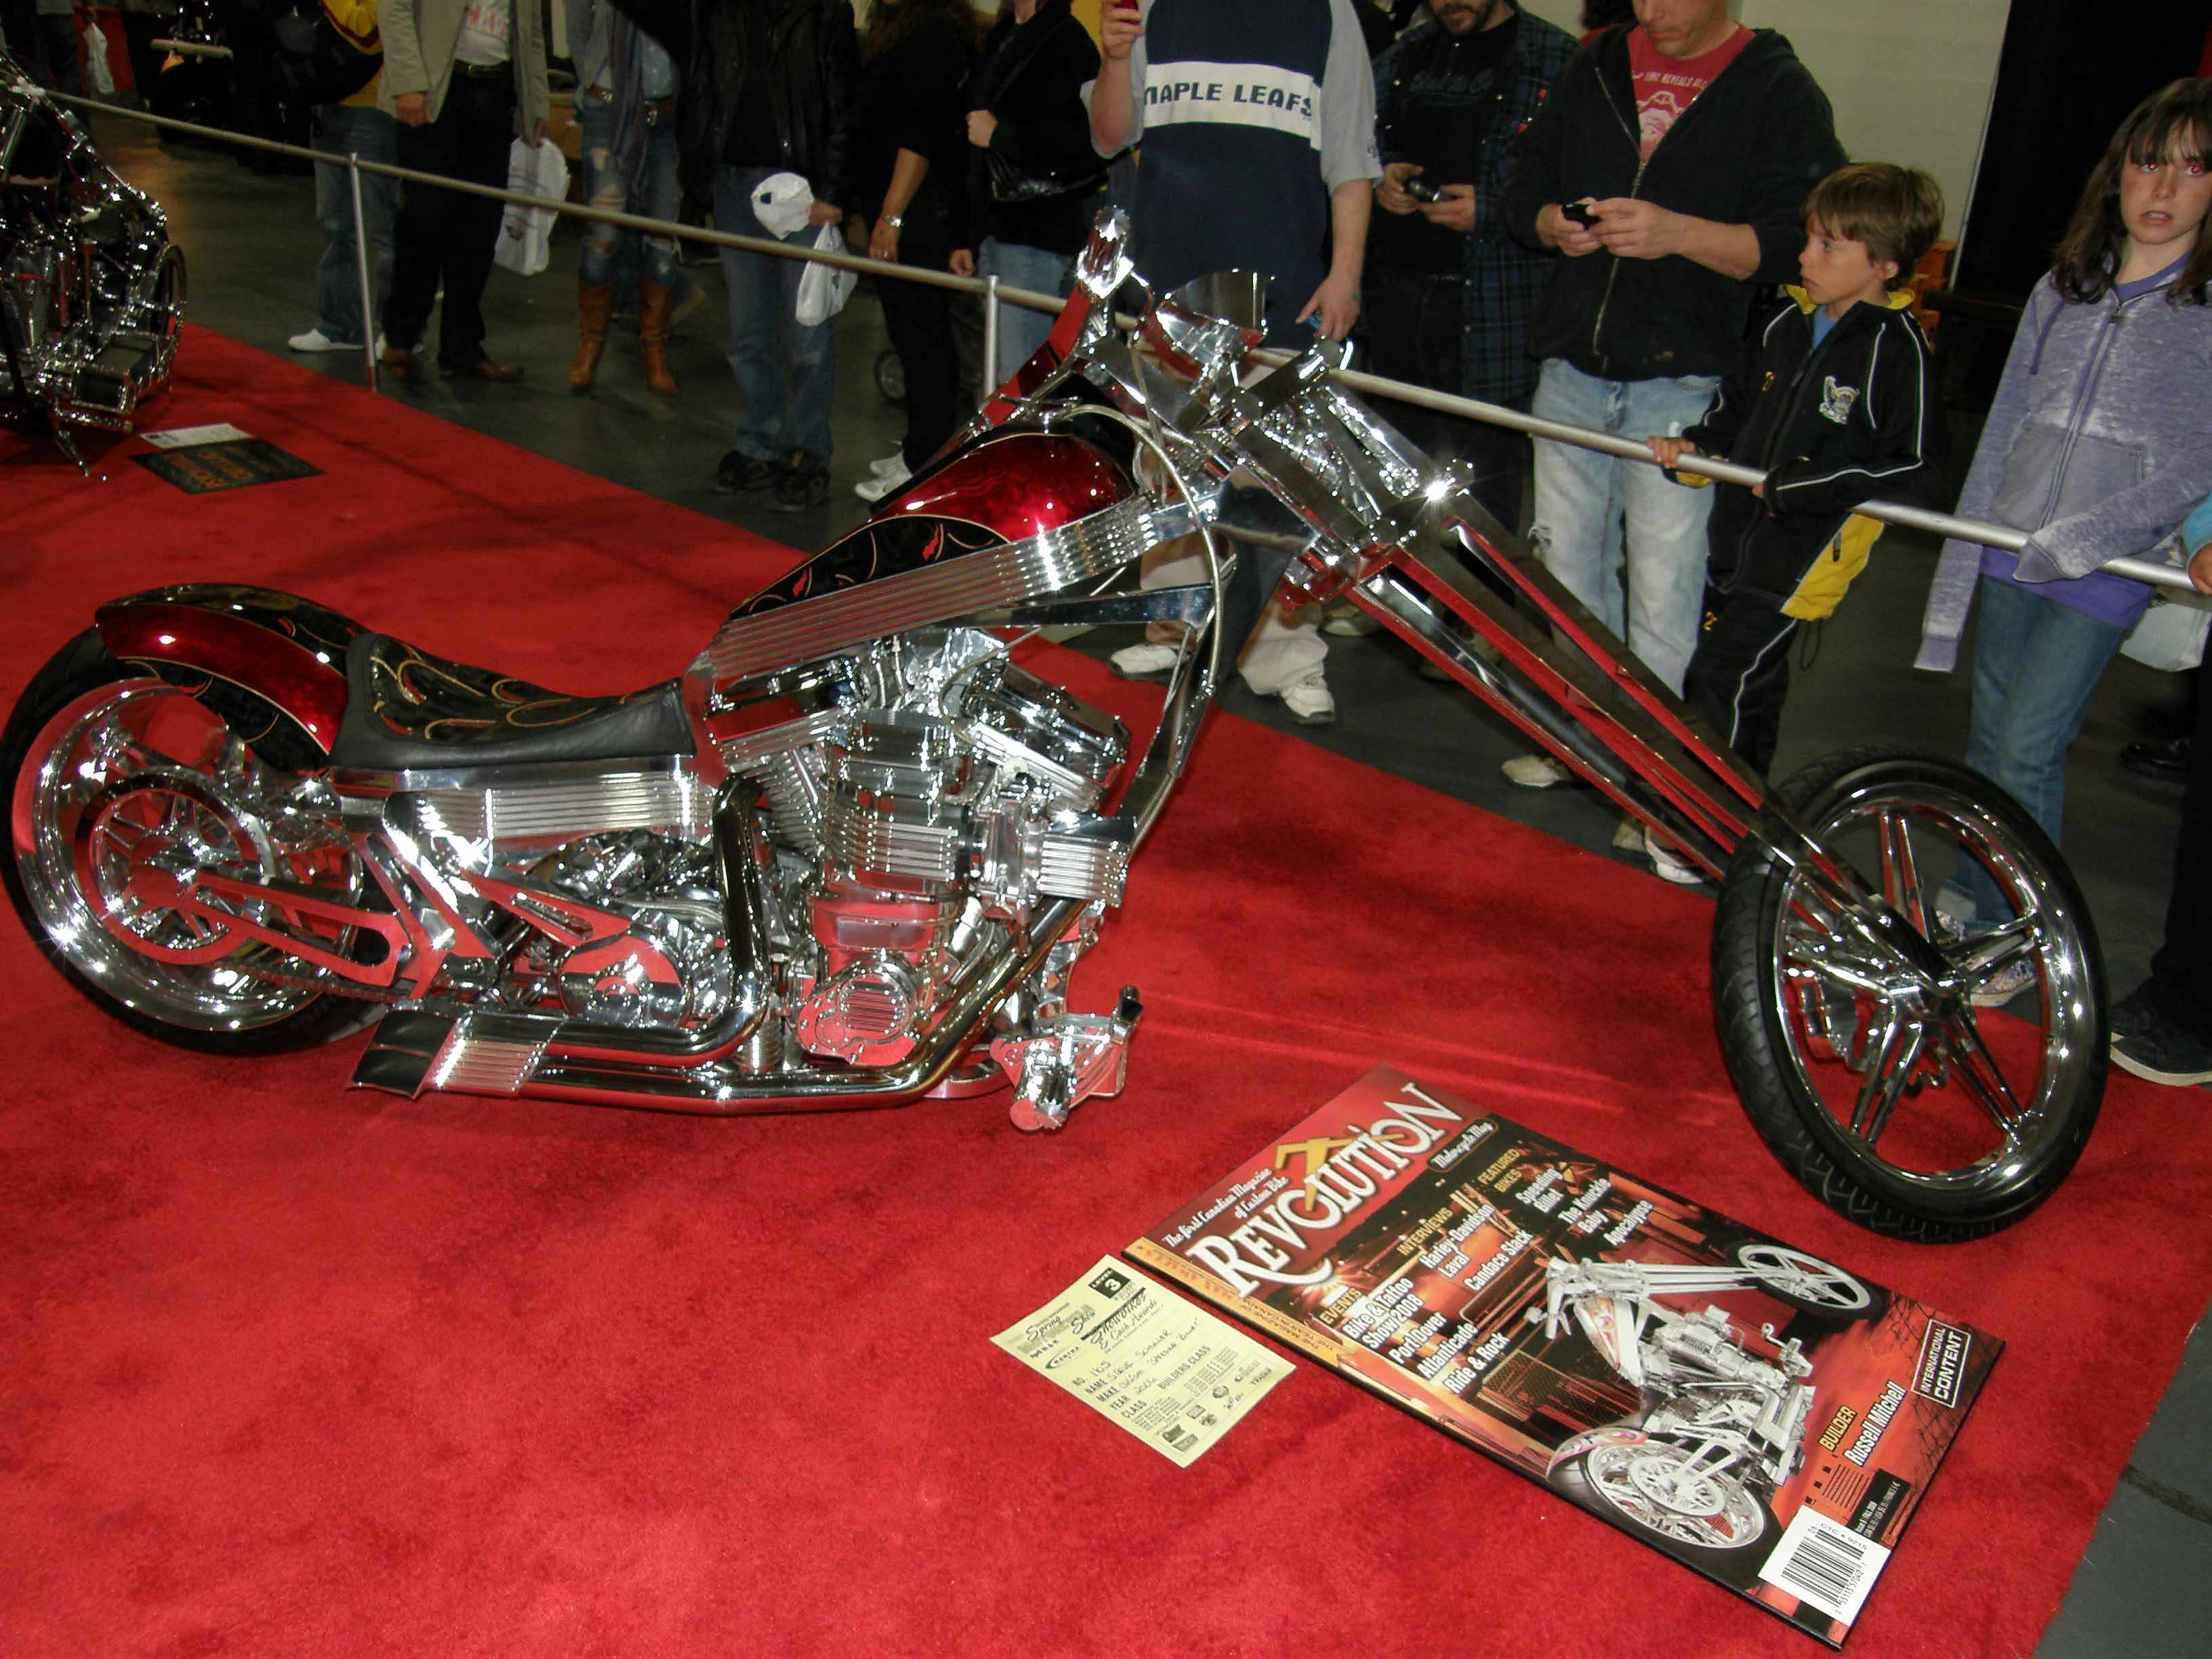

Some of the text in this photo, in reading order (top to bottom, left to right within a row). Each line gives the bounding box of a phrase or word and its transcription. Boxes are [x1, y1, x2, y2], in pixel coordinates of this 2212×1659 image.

[1144, 82, 1312, 117] MAPLE LEAFS
[1477, 1147, 1521, 1186] FEATURED
[1494, 1168, 1523, 1194] BIKES
[1515, 1167, 1564, 1206] Speeding
[1162, 1232, 1185, 1248] The
[1197, 1193, 1238, 1223] Canadian
[1228, 1168, 1273, 1198] Magazine
[1234, 1176, 1290, 1219] of Custom Bike
[1534, 1187, 1565, 1214] Billet
[1557, 1177, 1613, 1225] The Knuckle
[1396, 1208, 1454, 1256] INTERVIEWS
[1418, 1202, 1497, 1269] Harley-Davidson
[1577, 1209, 1611, 1234] Baby
[1603, 1200, 1654, 1247] Apocalypse
[1437, 1252, 1471, 1279] Laval
[1463, 1229, 1534, 1291] Candace Slack
[1104, 1278, 1122, 1292] 3
[1319, 1286, 1362, 1324] EVENTS
[1025, 1315, 1063, 1343] Spring
[1071, 1312, 1096, 1335] Show
[1341, 1277, 1415, 1340] Bike & Tattoo
[1361, 1293, 1425, 1350] Show 2008
[1388, 1311, 1448, 1365] Port Dover
[1416, 1321, 1479, 1380] Atlanticade
[1919, 1327, 1946, 1393] INTERNATIONAL
[1120, 1399, 1148, 1418] CLASS
[1157, 1361, 1191, 1390] BUILDERS
[1187, 1345, 1212, 1365] CLASS
[1443, 1330, 1511, 1395] Ride & Rock
[1933, 1331, 1963, 1401] CONTENT
[1084, 1378, 1108, 1394] NAME
[1095, 1386, 1120, 1403] MAKE
[1110, 1395, 1132, 1410] YEAR
[1818, 1405, 1858, 1451] BUILDER
[1843, 1419, 1883, 1467] Russell
[1867, 1380, 1908, 1429] Mitchell
[1820, 1522, 1839, 1536] CTC
